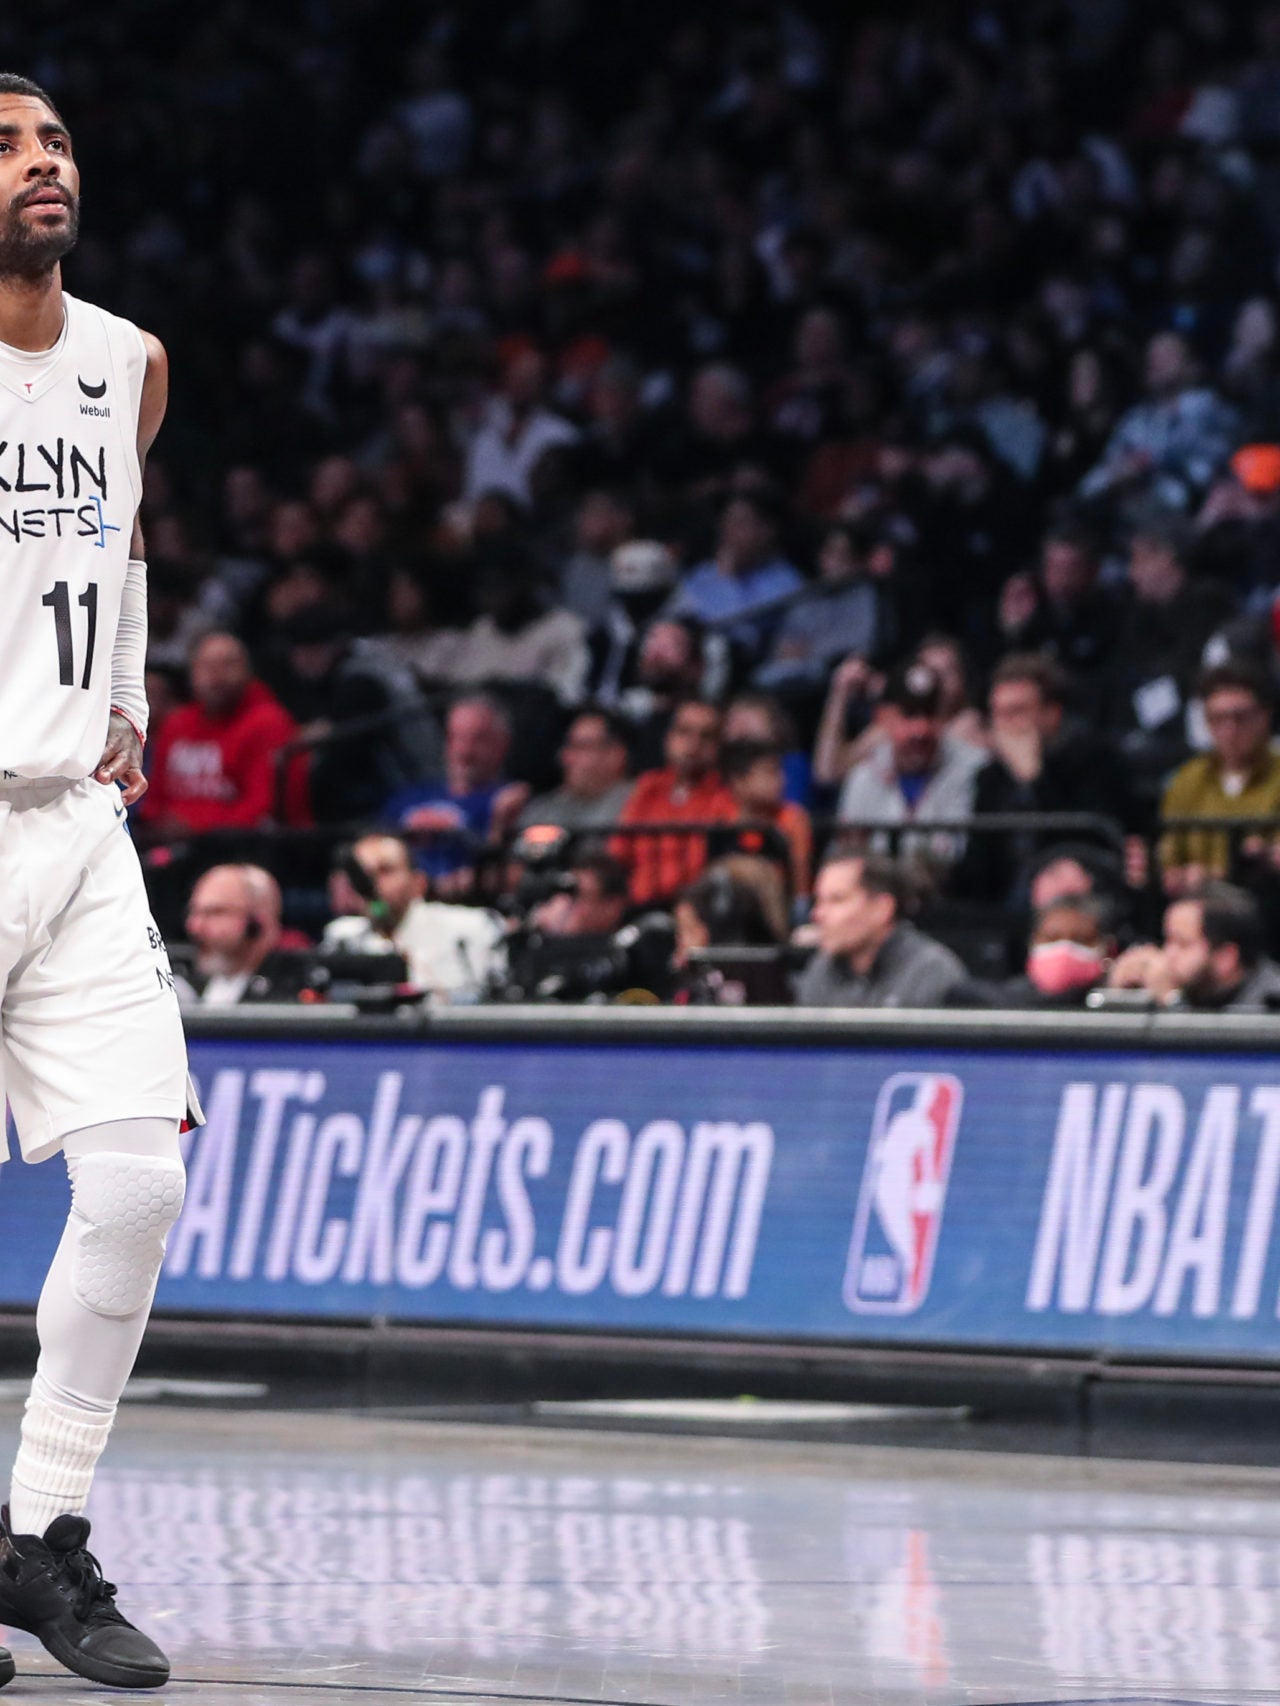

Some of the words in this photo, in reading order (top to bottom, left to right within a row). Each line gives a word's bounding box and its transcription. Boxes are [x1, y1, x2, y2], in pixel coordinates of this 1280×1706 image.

[79, 403, 111, 418] Webull
[41, 580, 99, 690] 11
[166, 1067, 776, 1300] ATickets.com
